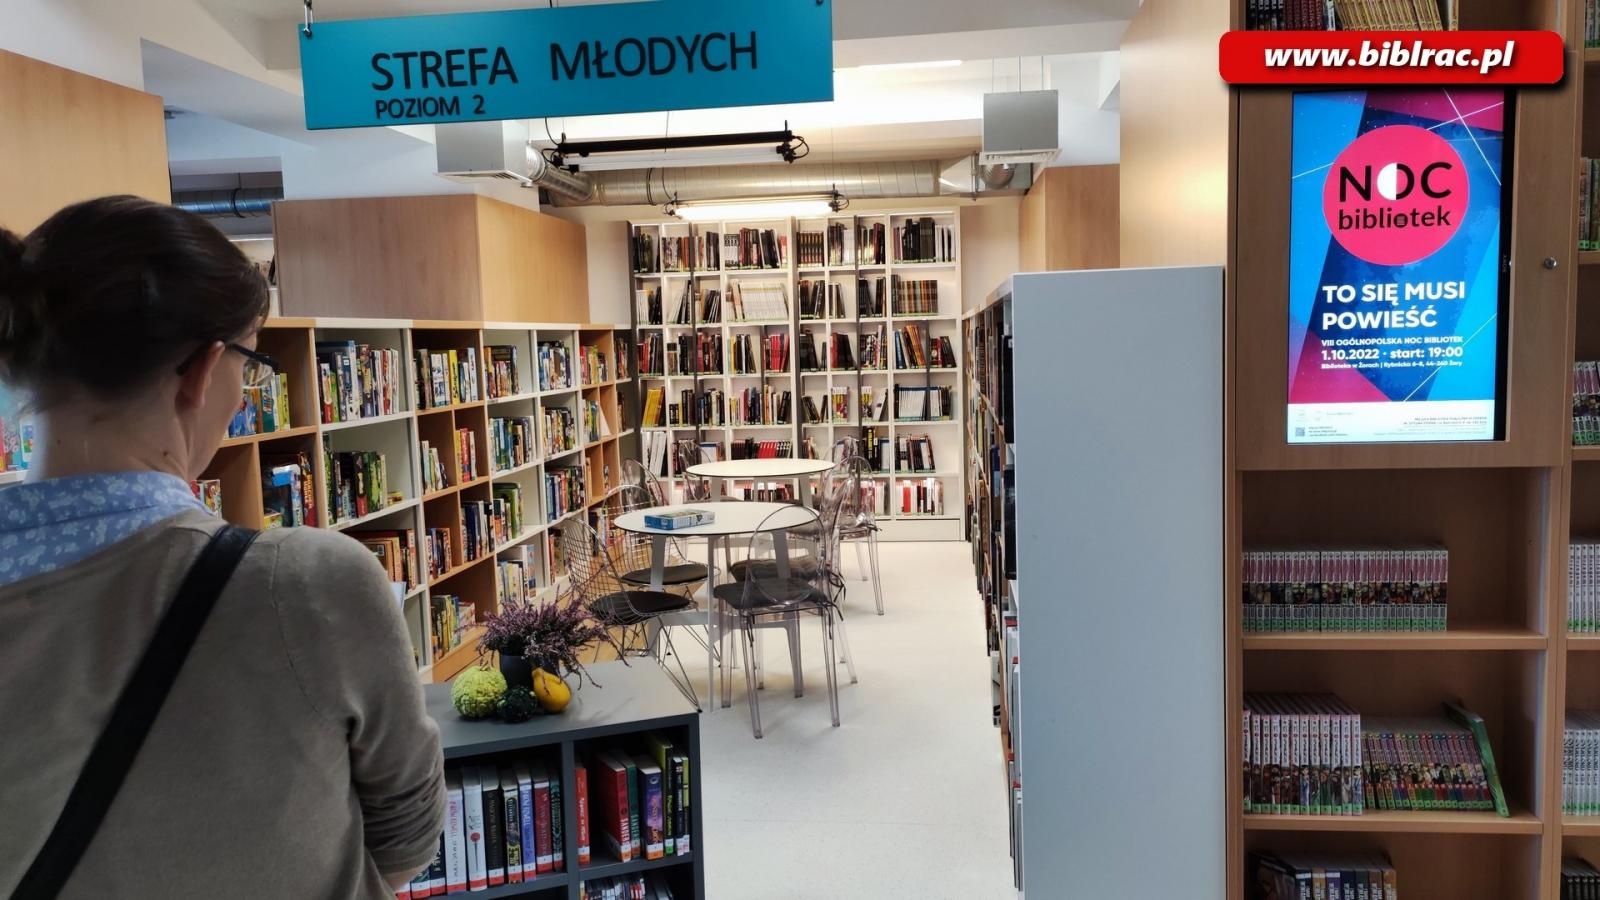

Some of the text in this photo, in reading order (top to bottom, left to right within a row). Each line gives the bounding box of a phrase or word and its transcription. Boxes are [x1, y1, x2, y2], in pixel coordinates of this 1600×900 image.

[372, 31, 758, 92] STREFA MŁODYCH
[376, 94, 486, 120] POZIOM 2
[1339, 162, 1453, 203] NOC
[1338, 205, 1452, 231] bibliotek
[1322, 281, 1466, 306] TO SIĘ MUSI
[1322, 305, 1438, 330] POWIEŚĆ
[1321, 336, 1464, 347] VIII OGÓLNOPOLSKA NOC BIBLIOTEK
[1321, 346, 1464, 361] 1.10.2022 start: 19:00
